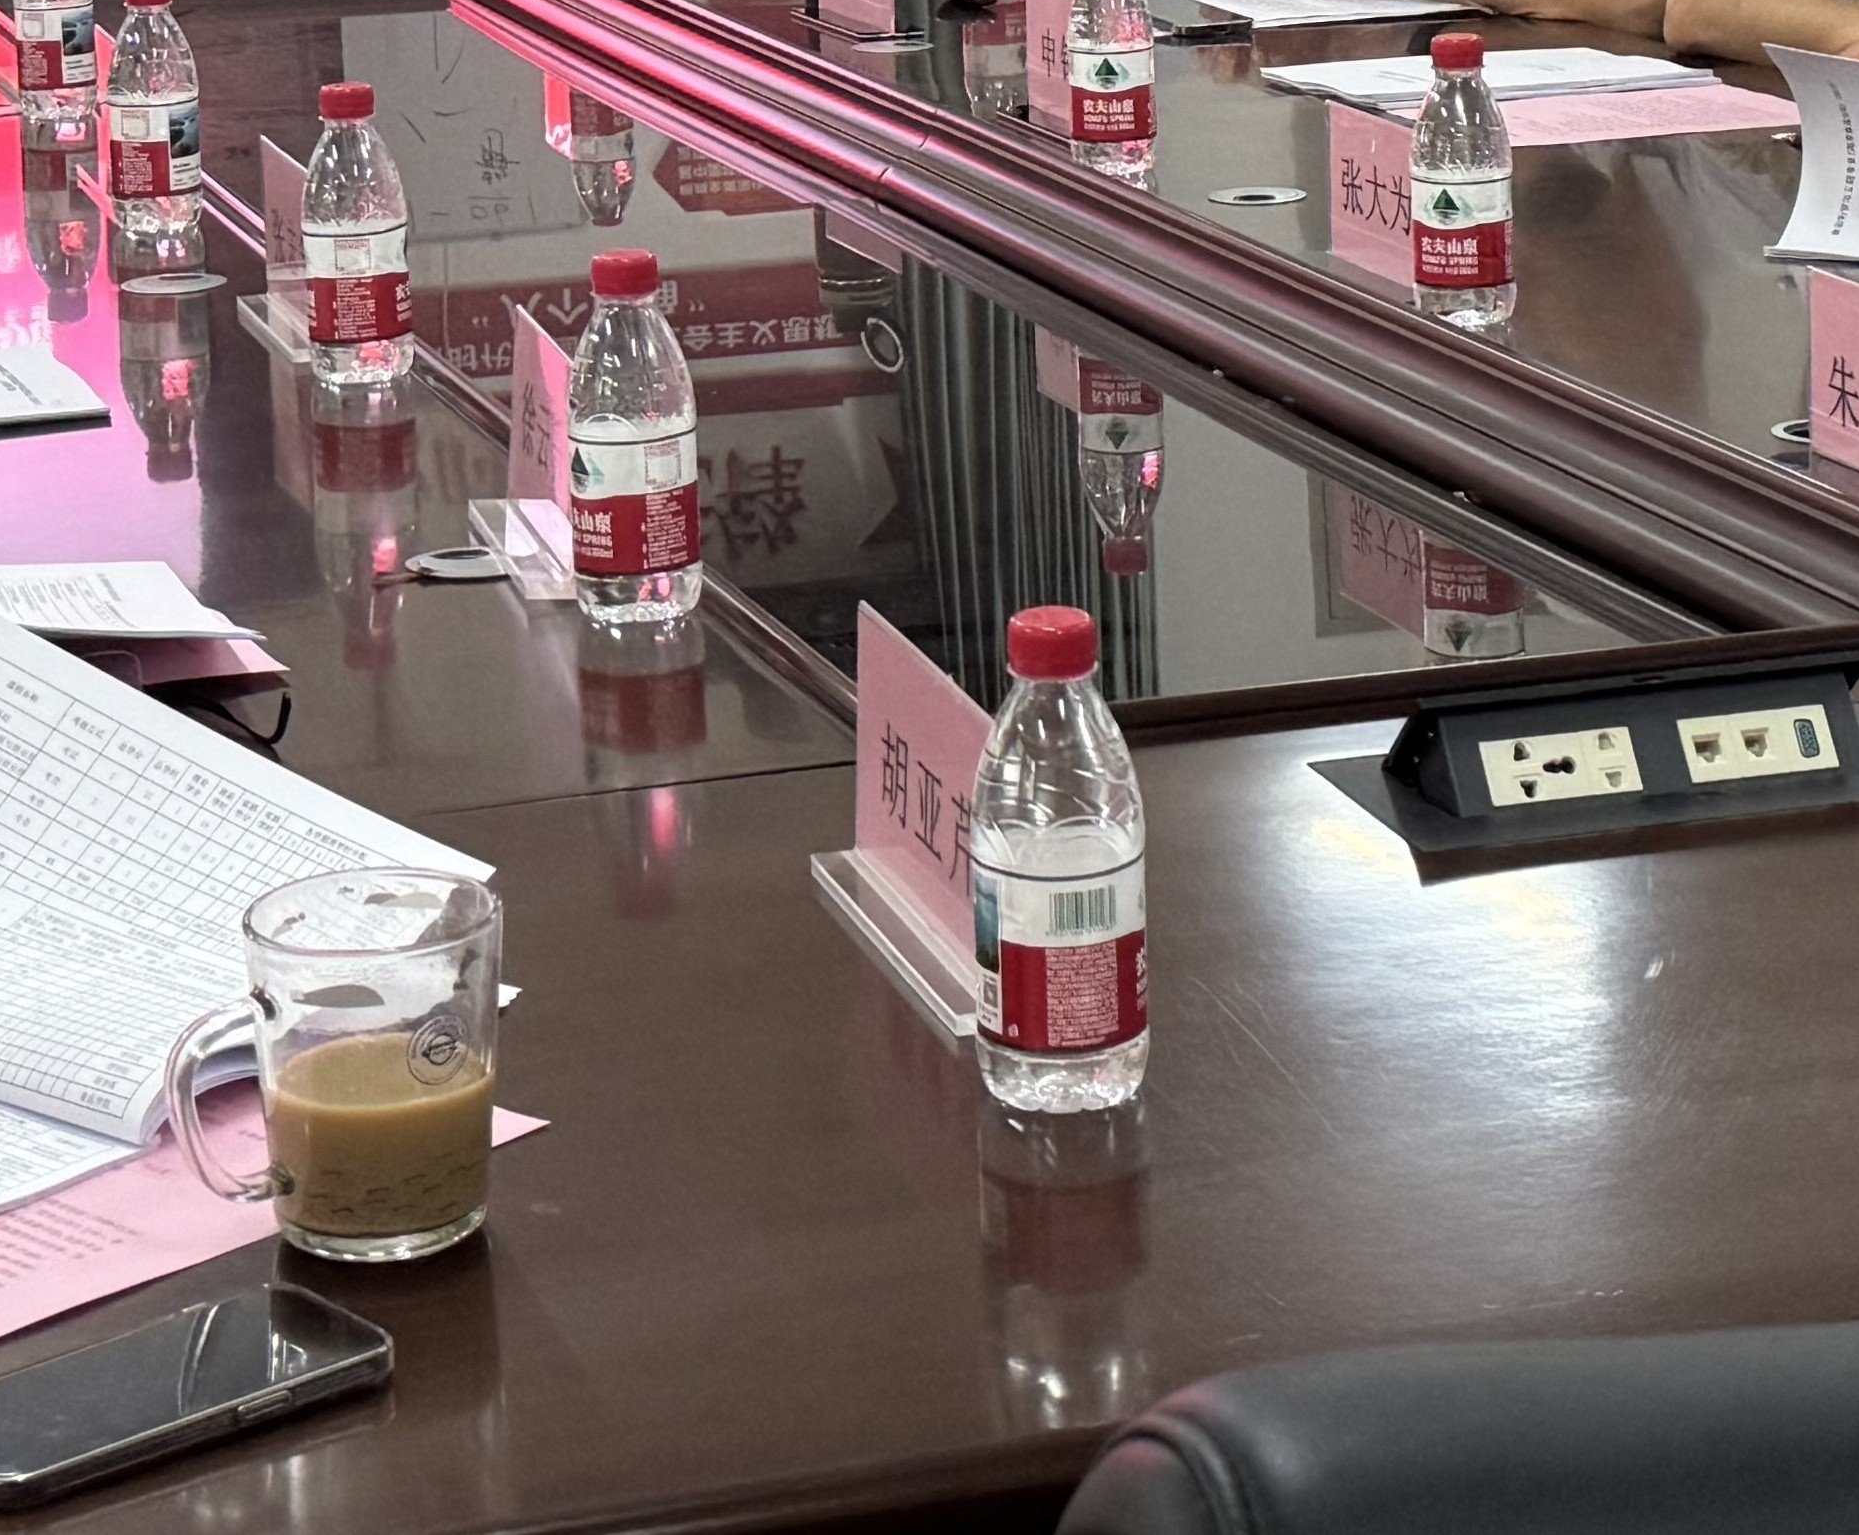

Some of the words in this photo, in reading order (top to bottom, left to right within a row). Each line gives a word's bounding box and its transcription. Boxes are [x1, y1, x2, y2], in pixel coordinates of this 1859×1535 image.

[1340, 157, 1413, 237] 张大为
[1421, 235, 1479, 256] 农夫山泉
